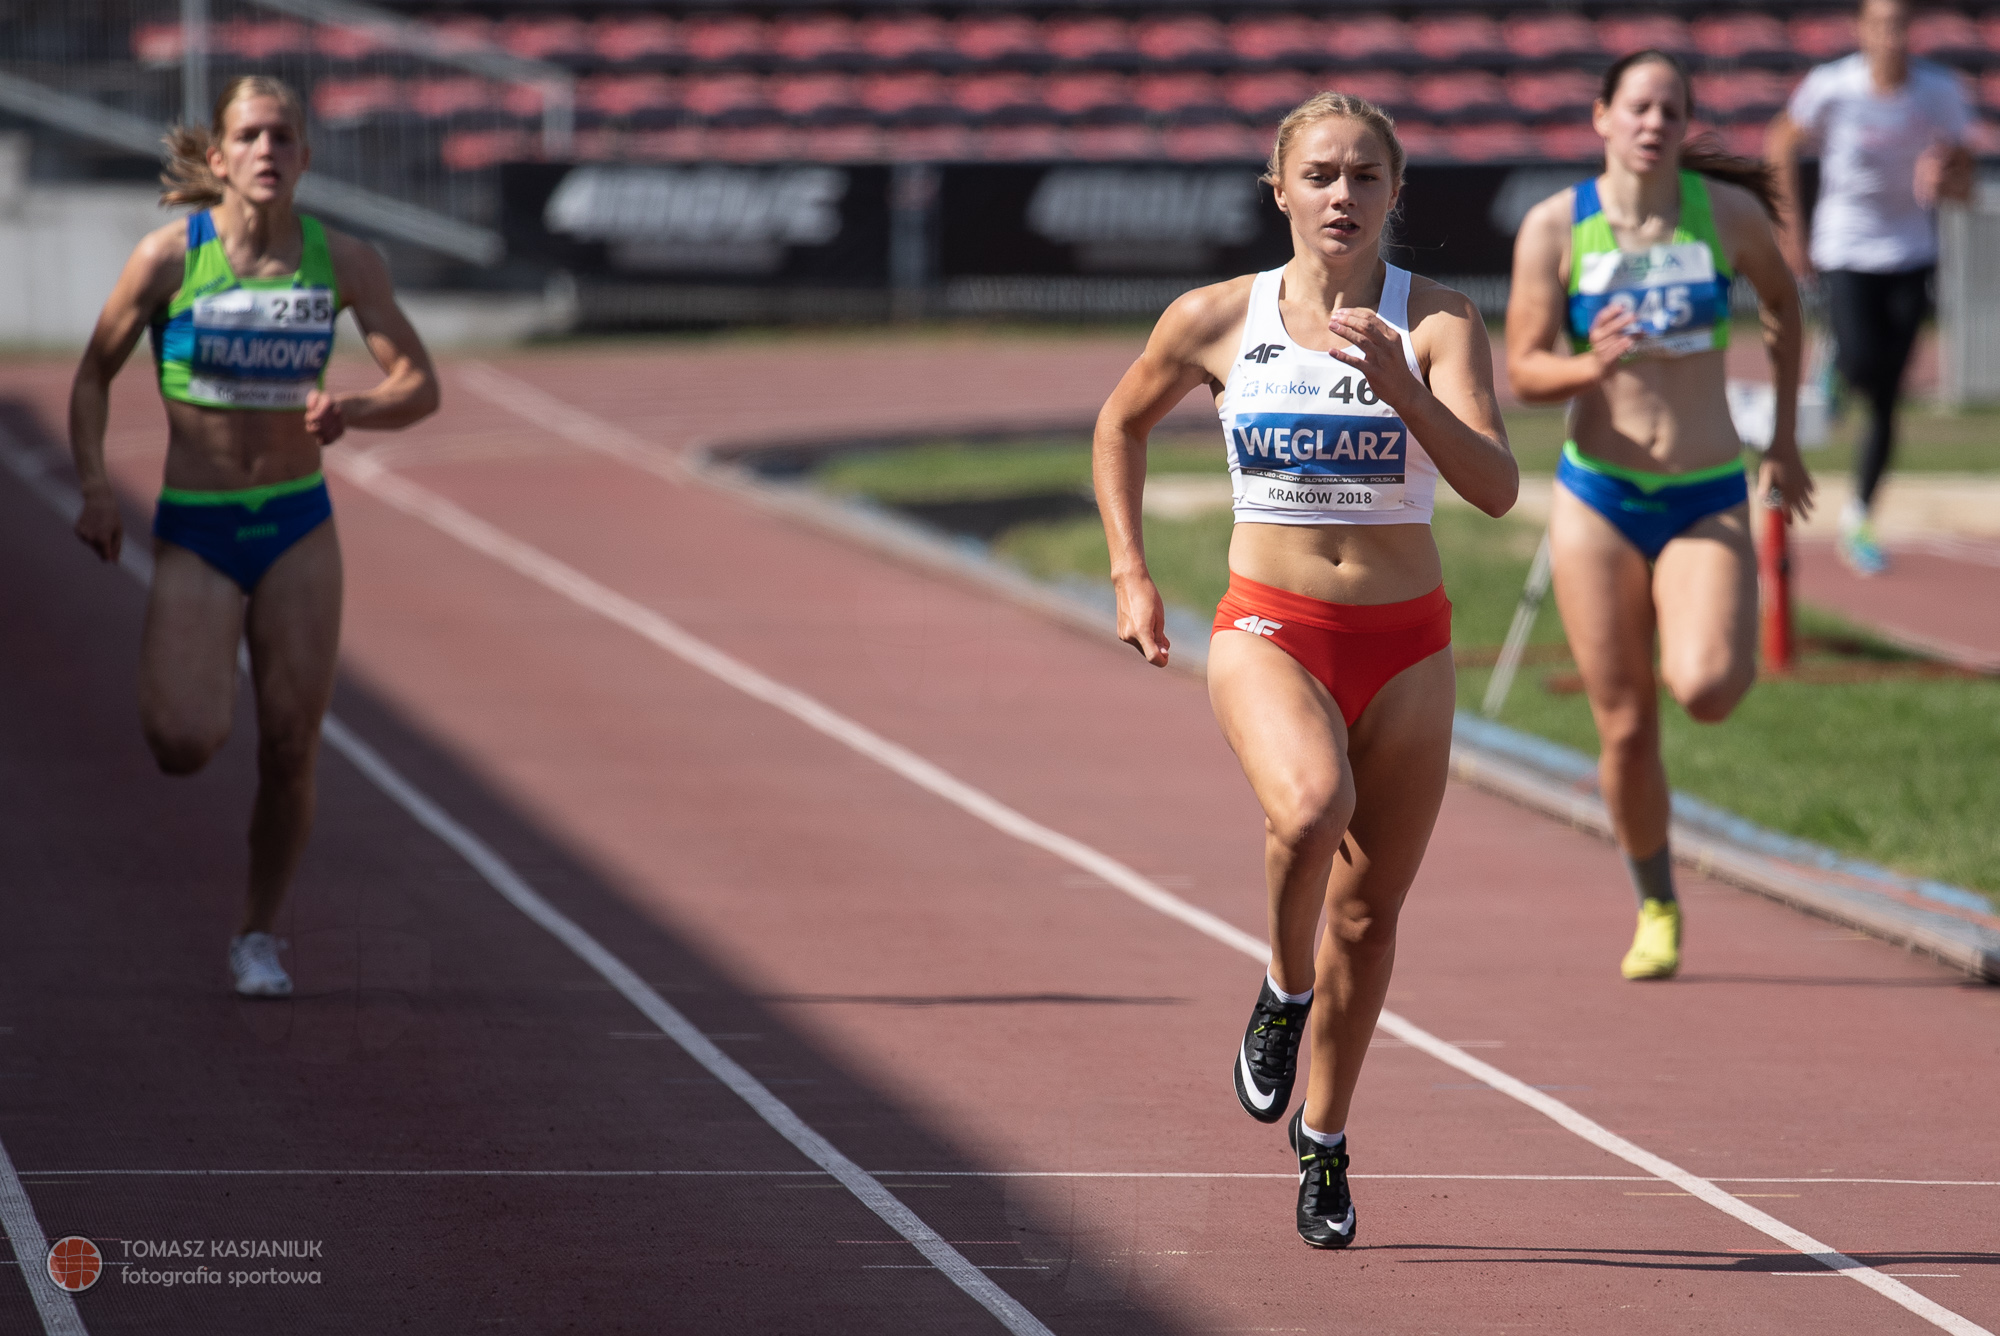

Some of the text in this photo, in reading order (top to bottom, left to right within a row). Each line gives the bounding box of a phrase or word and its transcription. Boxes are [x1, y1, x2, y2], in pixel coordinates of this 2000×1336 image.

[271, 297, 330, 322] 255
[199, 334, 328, 369] TRAJKOVIC
[1244, 343, 1286, 364] 4F
[1264, 380, 1320, 396] Kraków
[1328, 375, 1382, 406] 46
[1237, 426, 1401, 465] WĘGLARZ
[1268, 487, 1372, 505] KRAKÓW 2018
[1233, 615, 1283, 636] 4F
